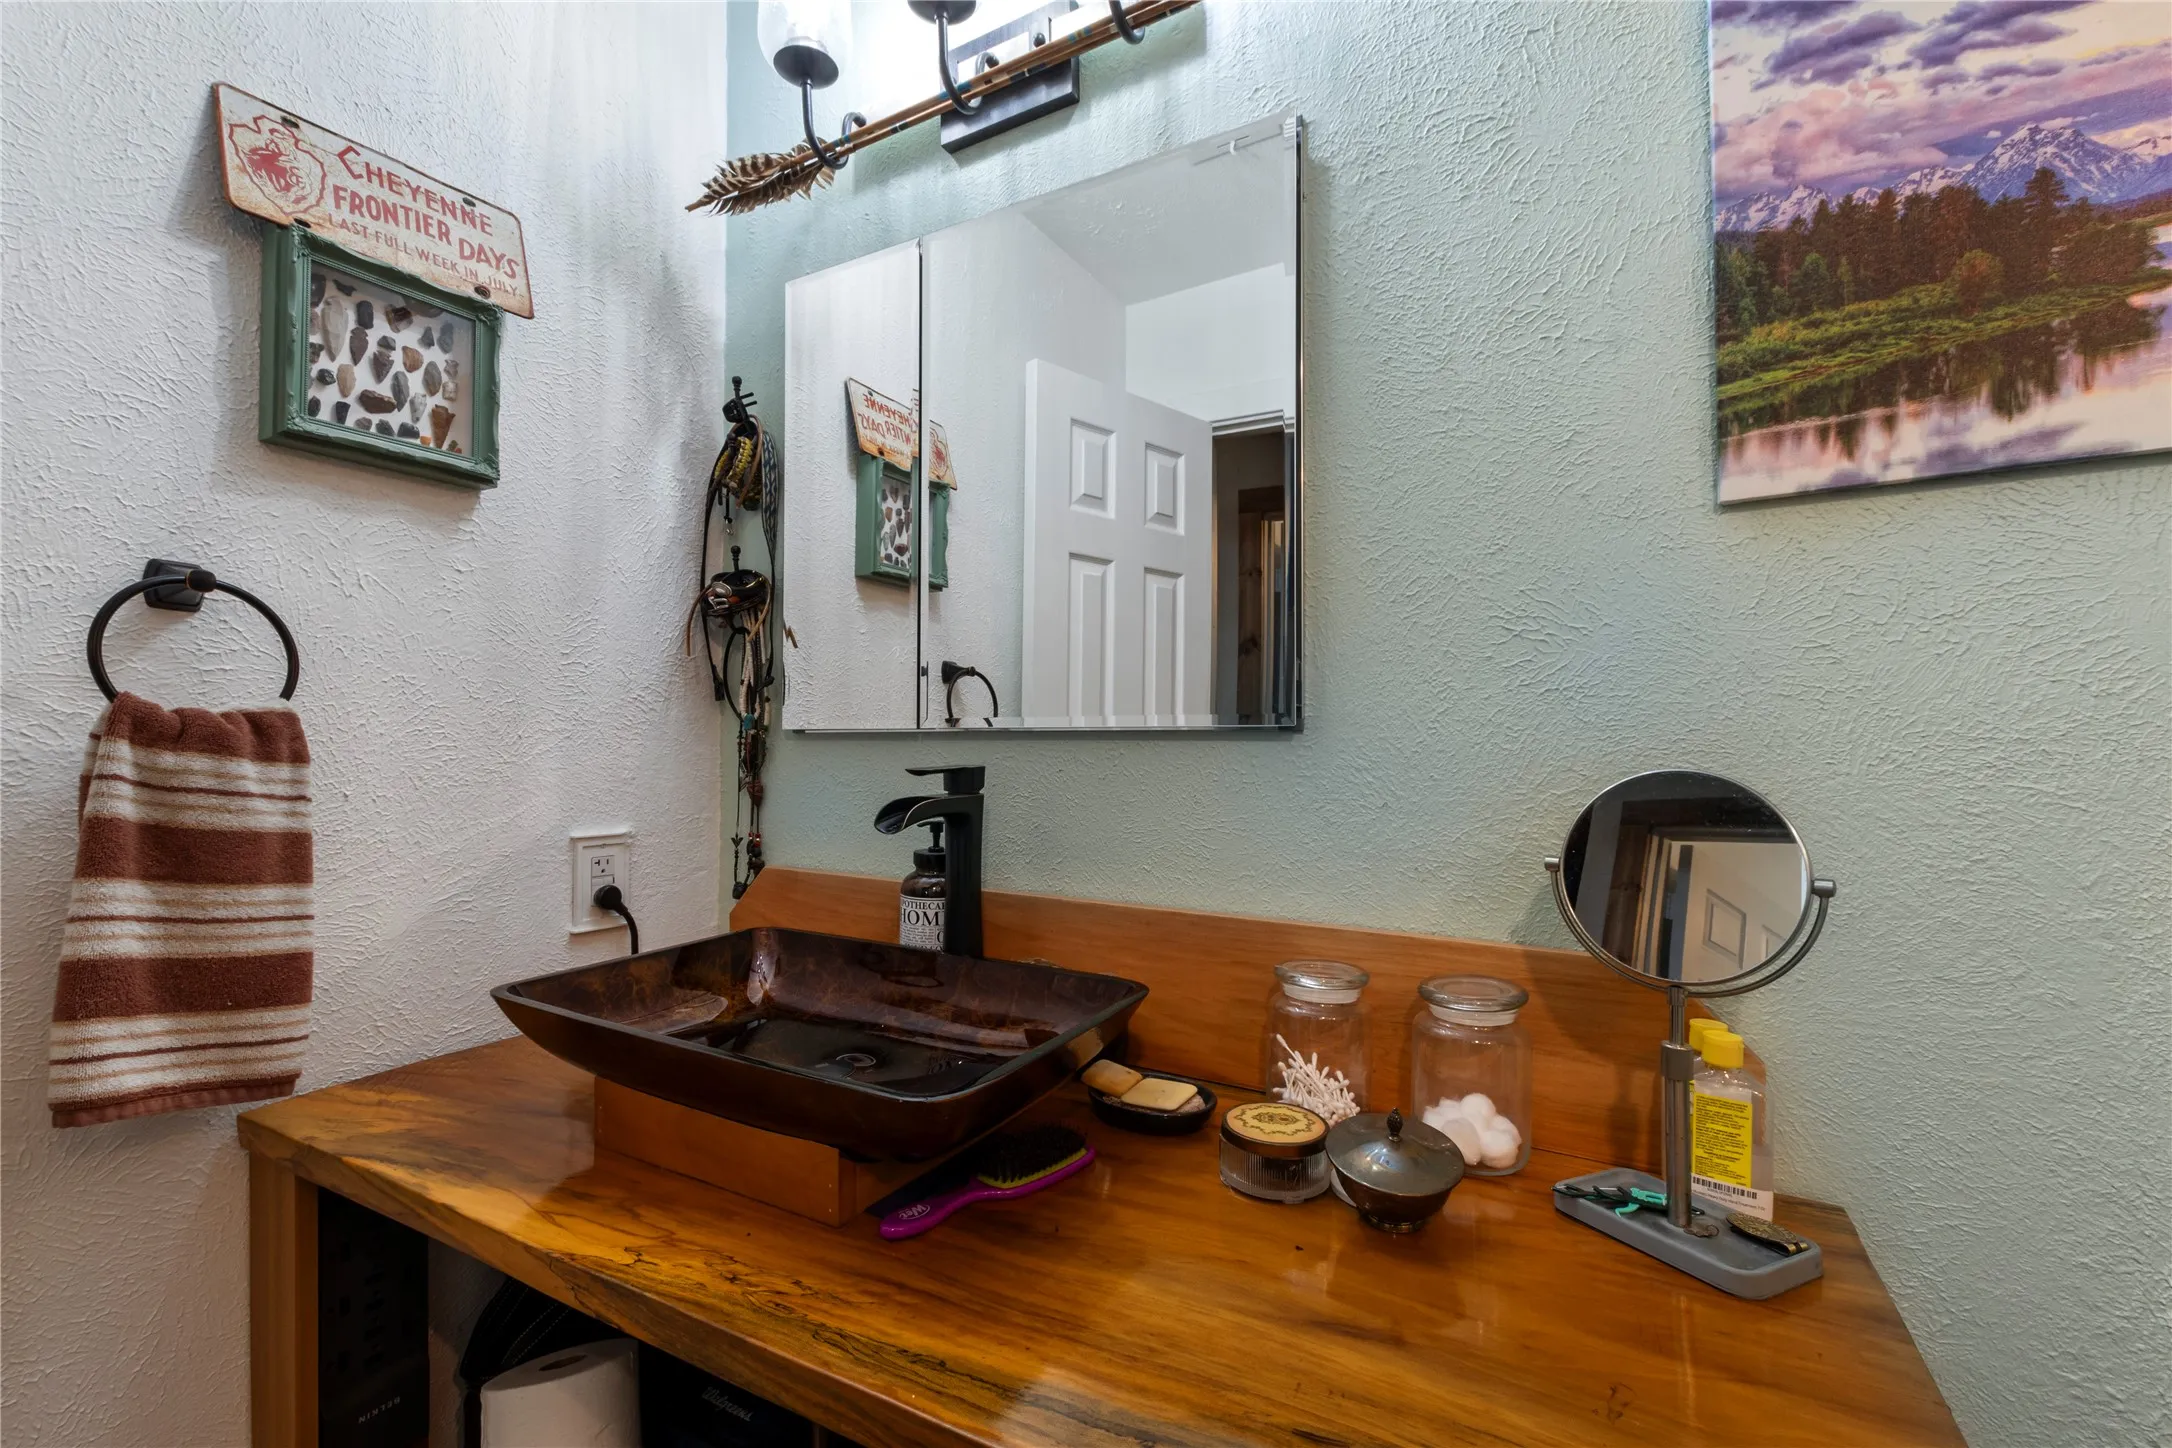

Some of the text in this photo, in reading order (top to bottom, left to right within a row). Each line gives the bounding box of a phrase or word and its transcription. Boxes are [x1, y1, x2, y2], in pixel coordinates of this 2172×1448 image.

[333, 184, 520, 279] FRONTIER DAYS
[337, 145, 493, 237] CHEYENNE
[328, 213, 518, 297] LAST FULL WEEK IN JULY
[899, 1204, 927, 1218] Wet
[358, 1395, 401, 1425] BELKIN
